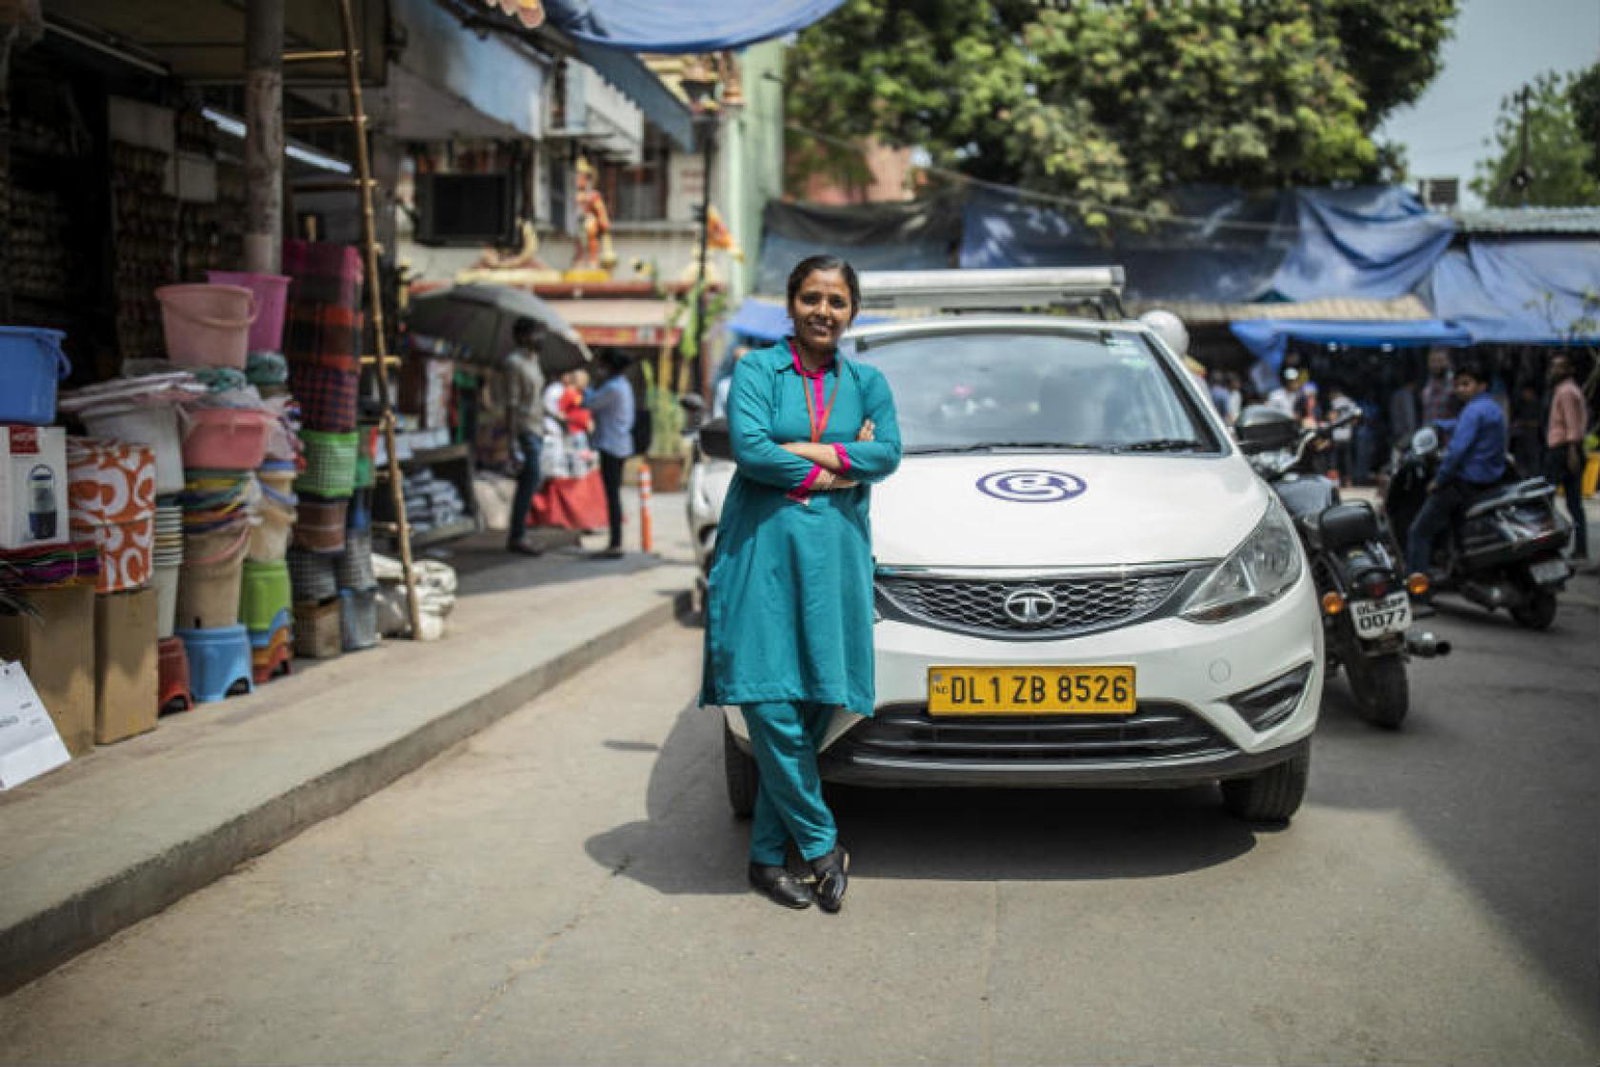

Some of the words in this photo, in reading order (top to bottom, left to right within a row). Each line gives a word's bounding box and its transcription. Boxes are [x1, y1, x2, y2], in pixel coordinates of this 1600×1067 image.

[1360, 608, 1407, 630] 0077
[1012, 675, 1046, 704] ZB
[1057, 674, 1128, 703] 8526
